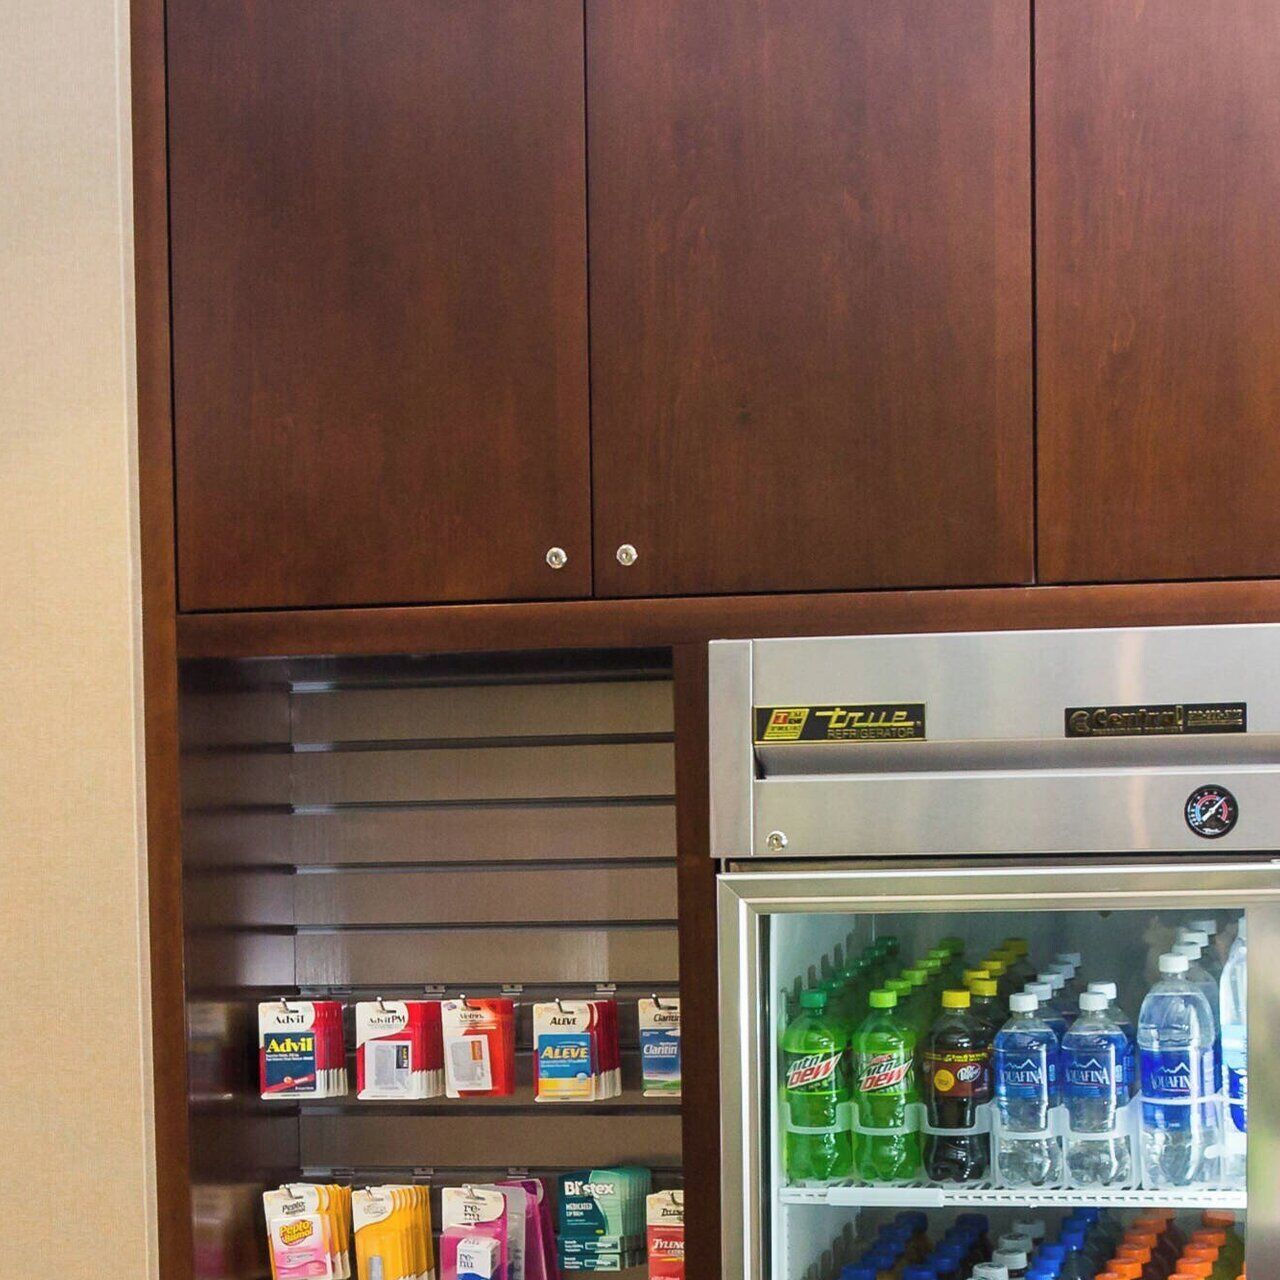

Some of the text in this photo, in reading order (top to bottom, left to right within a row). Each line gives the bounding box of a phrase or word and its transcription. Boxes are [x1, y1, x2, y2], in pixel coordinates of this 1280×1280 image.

[827, 727, 916, 739] REFRIGERATOR
[275, 1014, 305, 1024] Advil
[392, 1014, 406, 1024] PM
[550, 1016, 577, 1026] ALEVE
[266, 1037, 314, 1053] Advil
[643, 1043, 678, 1055] Claritin
[540, 1046, 589, 1060] ALEVE
[1150, 1072, 1190, 1090] AQUAFIN
